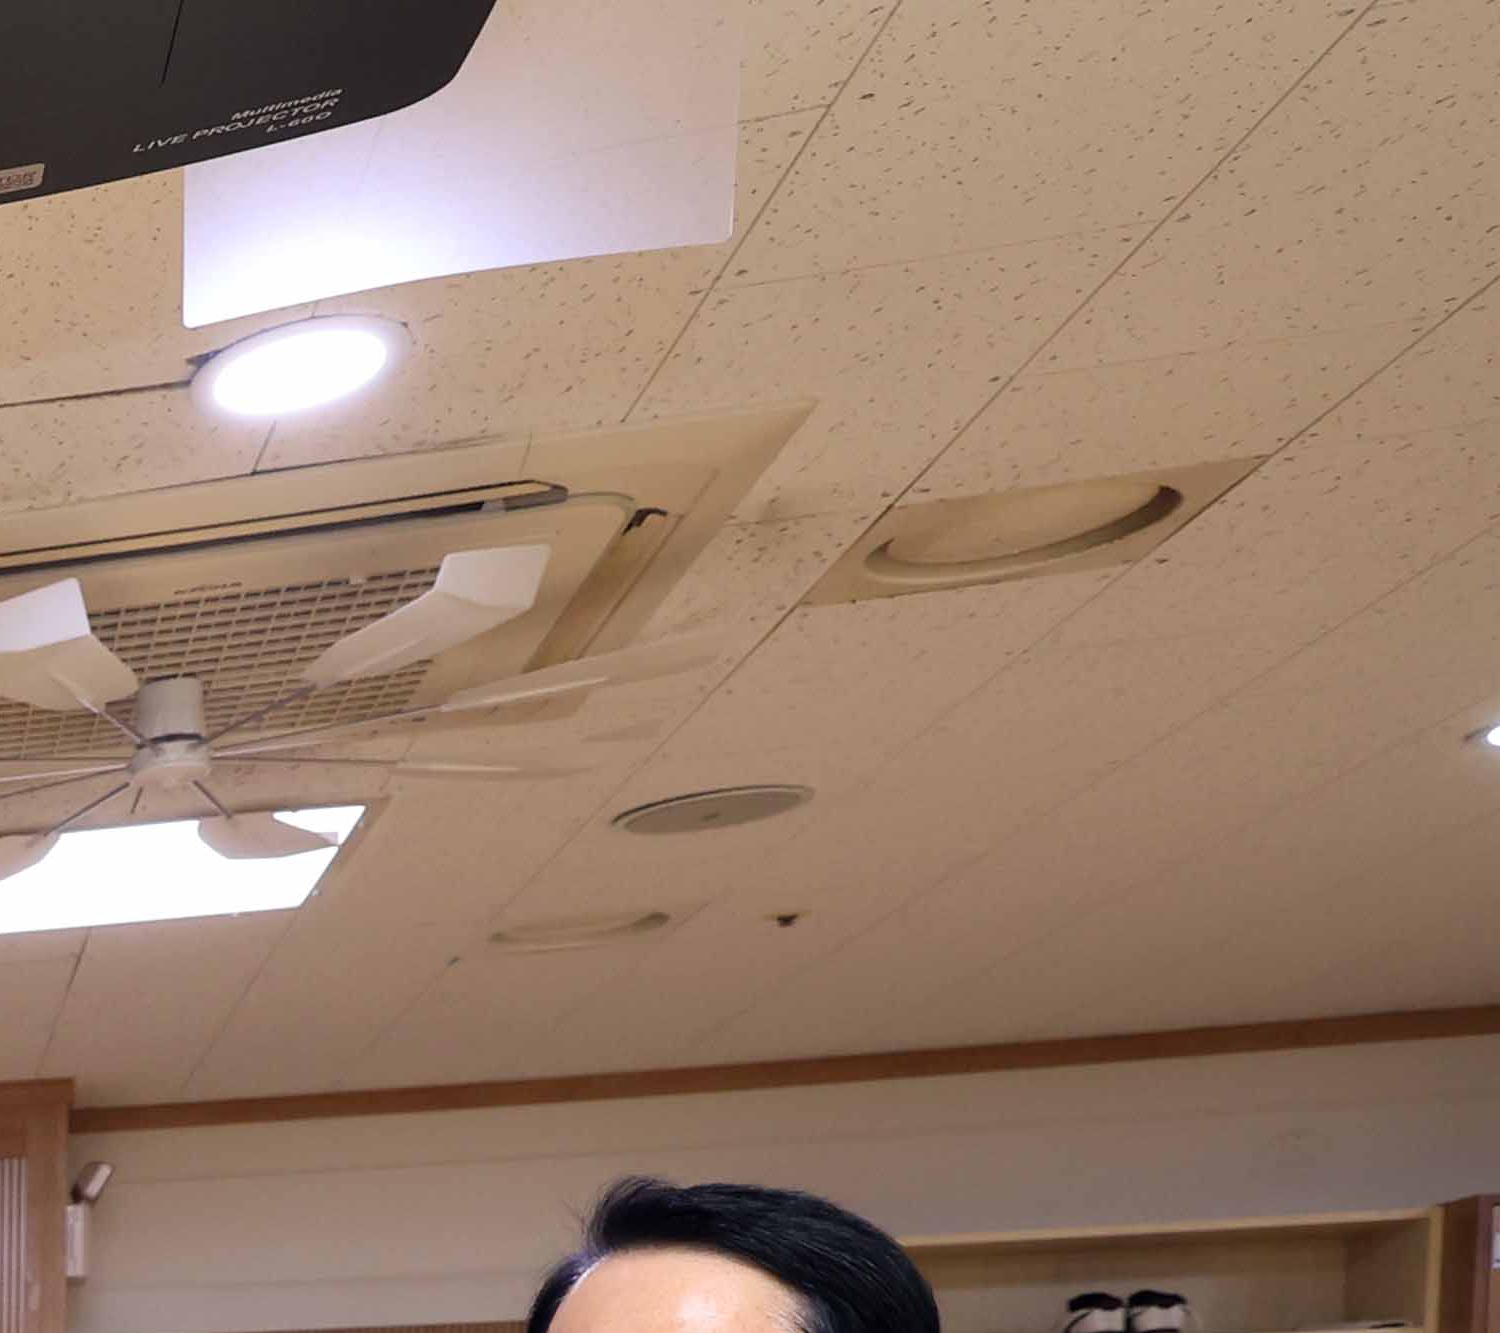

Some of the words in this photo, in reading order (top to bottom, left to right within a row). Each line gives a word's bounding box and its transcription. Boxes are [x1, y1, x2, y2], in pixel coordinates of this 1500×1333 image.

[132, 132, 189, 153] LIVE
[192, 98, 340, 141] PROJECTOR
[230, 88, 343, 121] Multimedia
